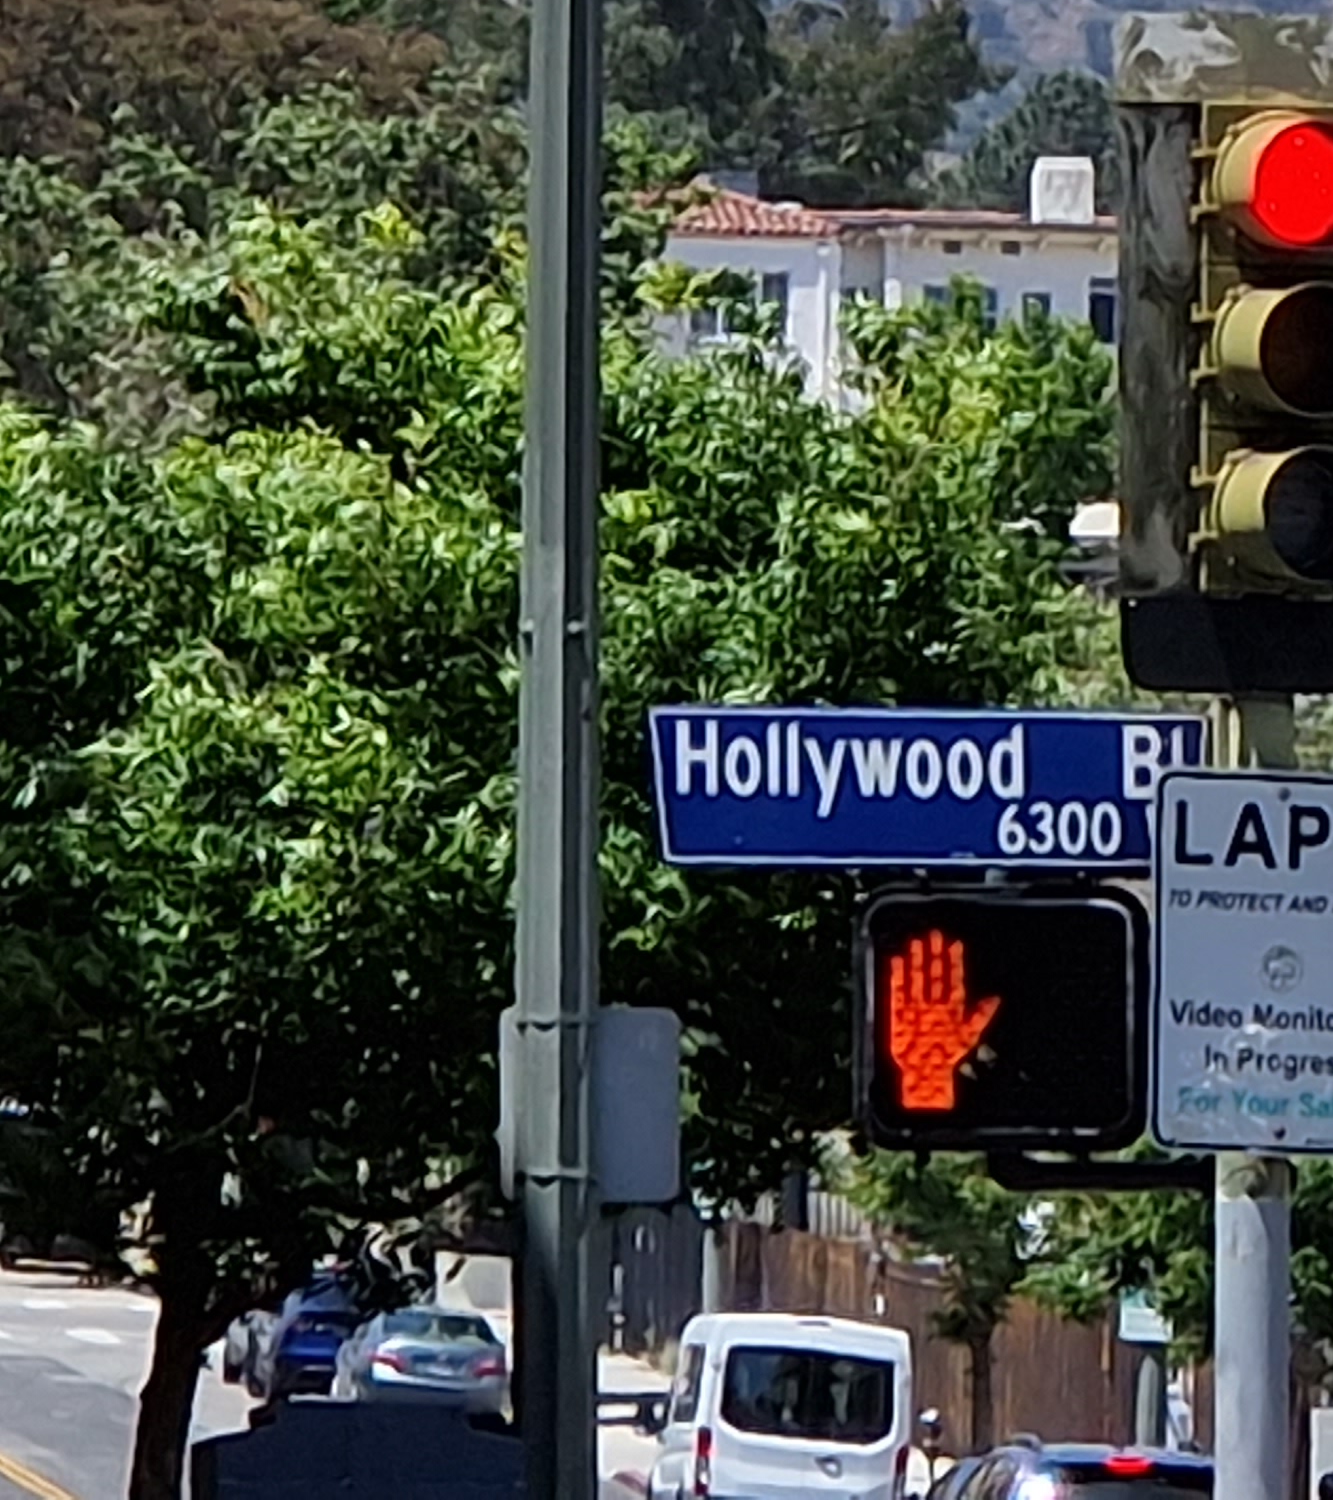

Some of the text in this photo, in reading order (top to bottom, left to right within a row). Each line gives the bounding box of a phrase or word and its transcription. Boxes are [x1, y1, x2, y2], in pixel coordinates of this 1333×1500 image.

[675, 719, 1026, 818] Hollywood
[999, 801, 1122, 856] 6300
[1169, 888, 1192, 907] TO
[1196, 890, 1285, 912] PROTECT
[1287, 896, 1328, 914] AND
[1169, 999, 1243, 1028] Video
[1204, 1044, 1229, 1070] In
[1177, 1086, 1222, 1113] For
[1232, 1089, 1289, 1116] Your
